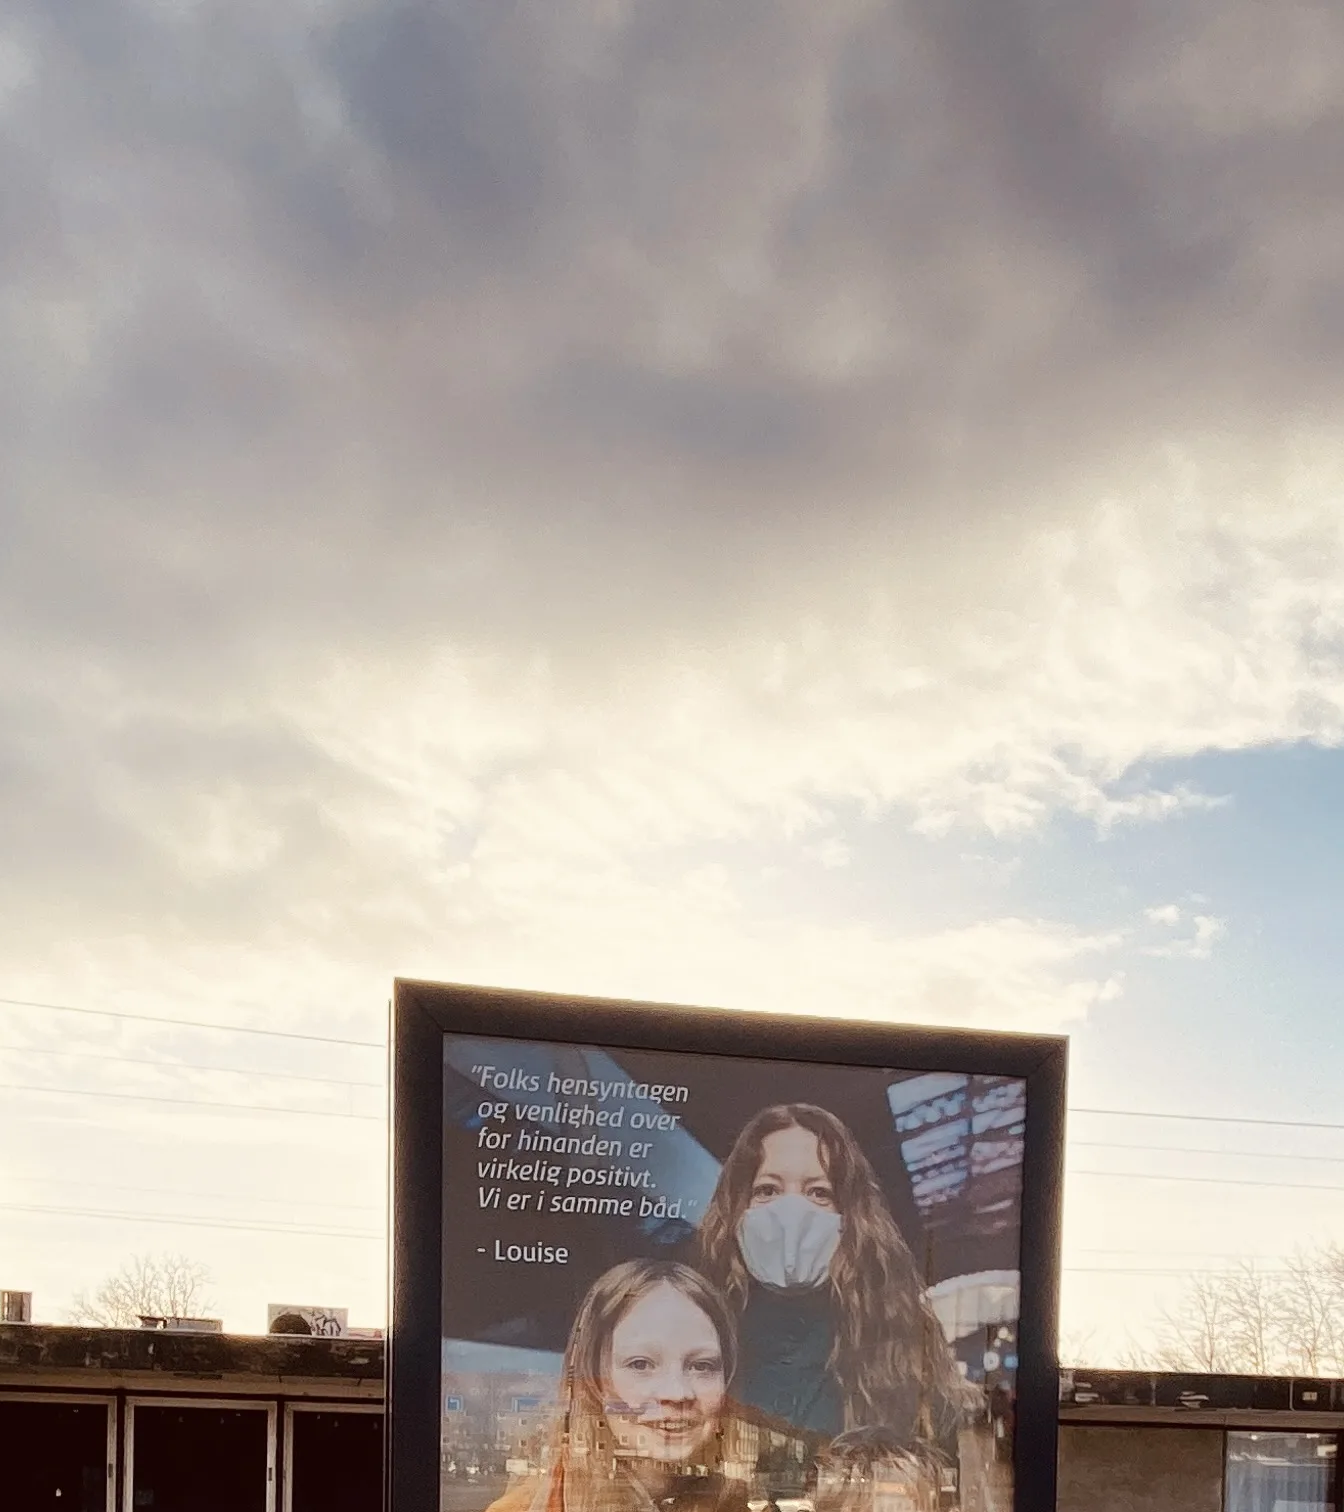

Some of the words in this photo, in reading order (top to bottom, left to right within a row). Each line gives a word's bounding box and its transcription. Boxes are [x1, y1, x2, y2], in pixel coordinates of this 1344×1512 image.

[547, 1072, 689, 1102] hensyntagen
[477, 1101, 508, 1123] og
[514, 1102, 623, 1129] venlighed
[630, 1111, 681, 1131] over
[477, 1127, 511, 1150] for
[518, 1129, 622, 1157] hinanden
[629, 1141, 653, 1159] er
[477, 1158, 561, 1185] virkelig
[566, 1166, 657, 1189] positivt.
[479, 1187, 501, 1209] Vi
[506, 1194, 532, 1211] er
[536, 1190, 545, 1211] i
[550, 1195, 631, 1217] samme
[494, 1240, 569, 1264] Louise
